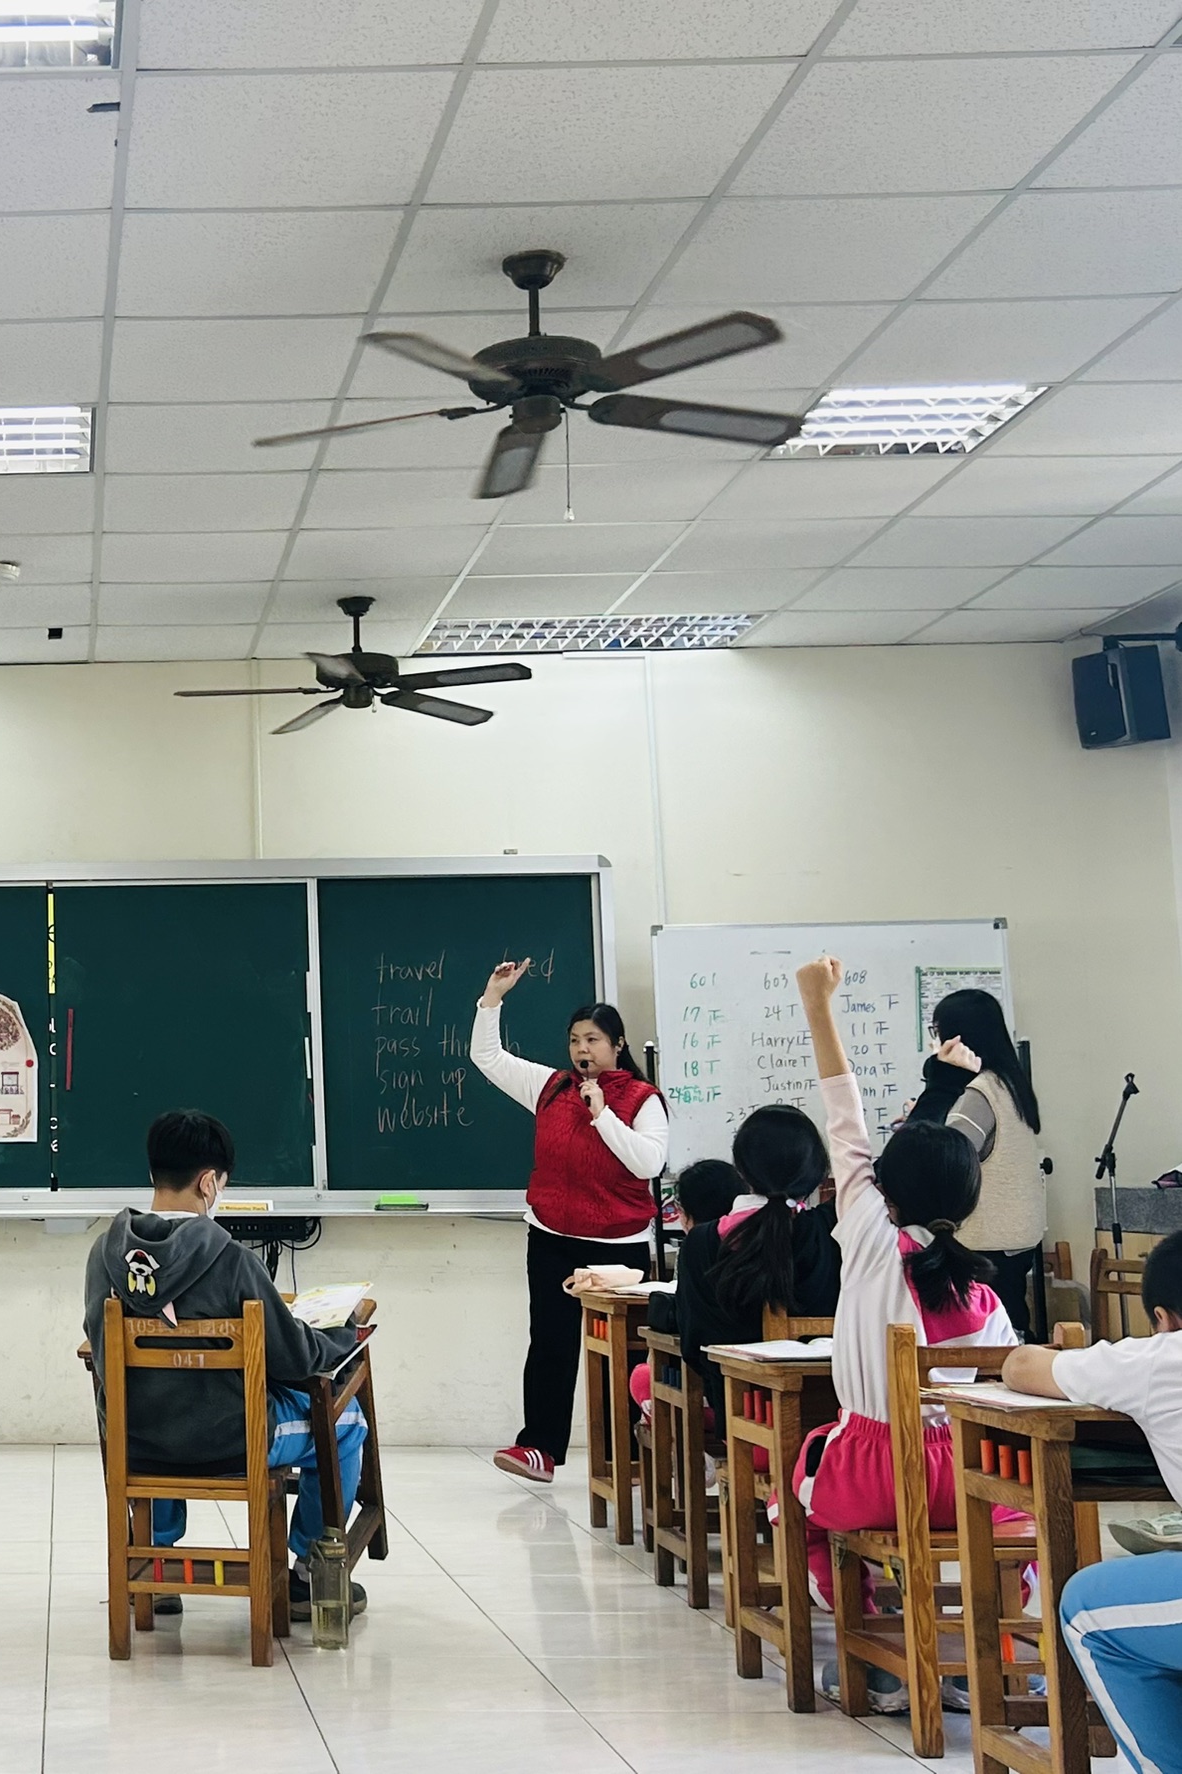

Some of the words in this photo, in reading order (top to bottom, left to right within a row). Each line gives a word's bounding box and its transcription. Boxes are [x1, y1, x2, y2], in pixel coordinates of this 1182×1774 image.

[376, 949, 446, 984] travel
[689, 972, 717, 989] 601
[763, 973, 789, 990] 603
[844, 969, 868, 986] 608
[371, 985, 433, 1027] trail
[764, 1004, 781, 1021] 24
[839, 994, 876, 1014] James
[682, 1006, 701, 1023] 17
[682, 1032, 699, 1050] 16
[751, 1031, 795, 1054] Harry
[851, 1044, 869, 1055] 20
[375, 1036, 421, 1078] pass
[756, 1053, 798, 1069] Claire
[684, 1060, 700, 1078] 18
[378, 1069, 424, 1104] sign
[441, 1067, 467, 1100] up
[759, 1075, 803, 1093] Justin
[377, 1091, 475, 1133] website
